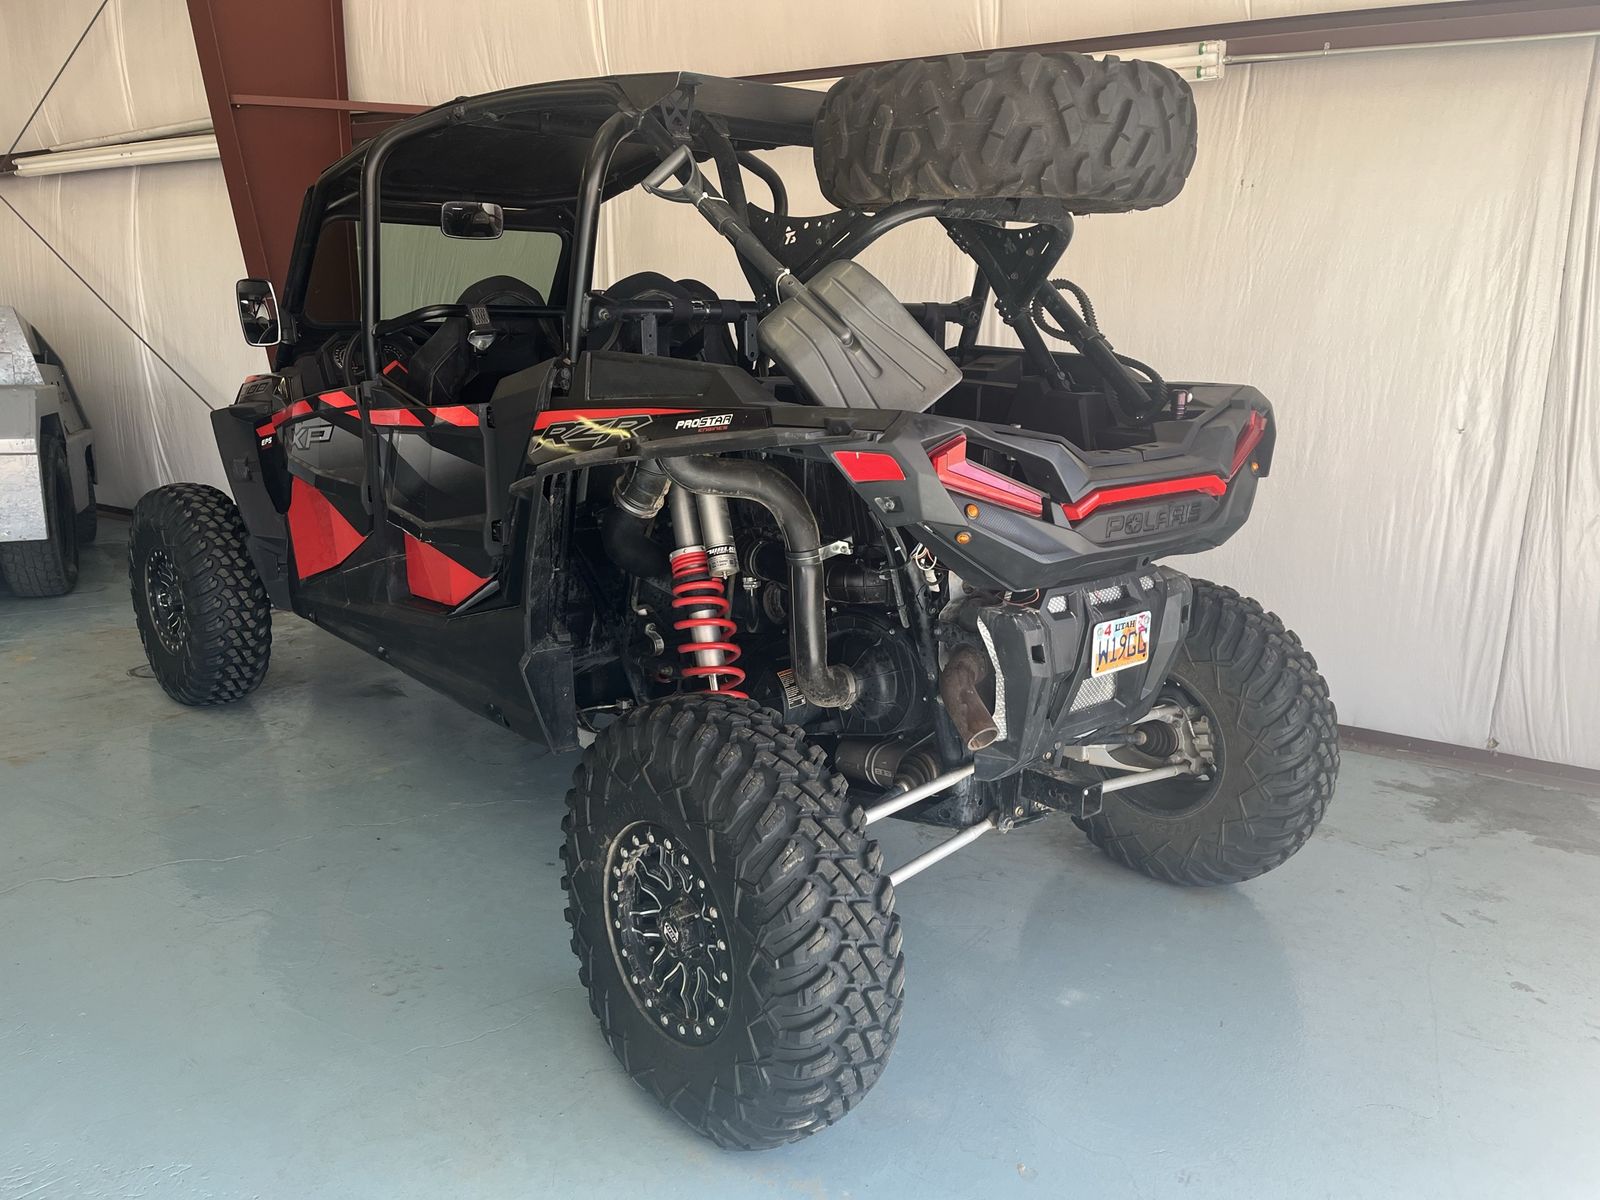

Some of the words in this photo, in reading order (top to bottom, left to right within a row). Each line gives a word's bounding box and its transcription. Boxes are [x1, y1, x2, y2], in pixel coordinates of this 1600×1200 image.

[675, 413, 733, 430] PROSTAR
[261, 436, 273, 446] EPS
[286, 422, 334, 451] XP
[530, 415, 653, 454] RZR
[1105, 502, 1202, 539] POLARIS
[1104, 623, 1112, 637] 4
[1115, 620, 1136, 632] UTAH
